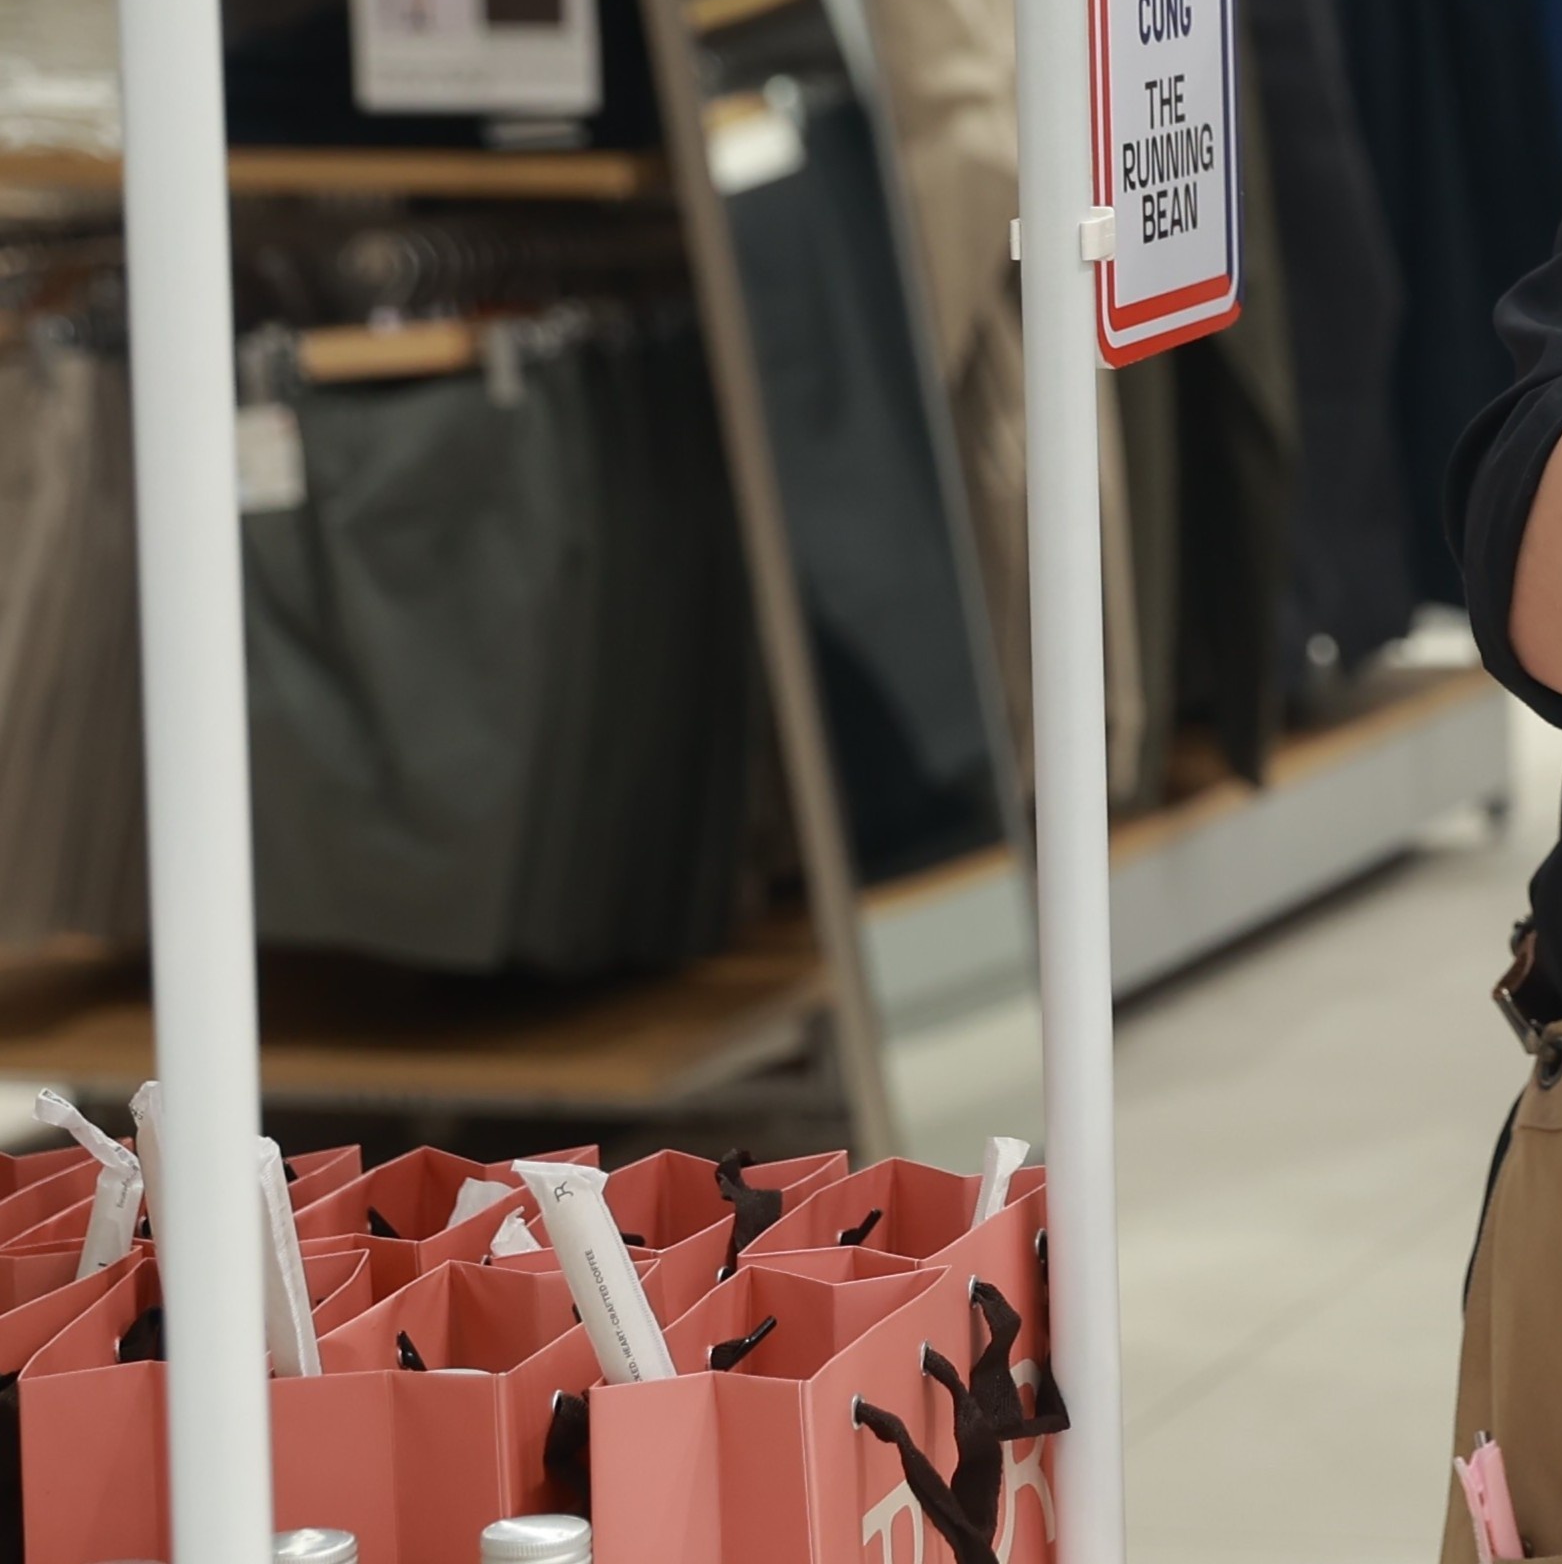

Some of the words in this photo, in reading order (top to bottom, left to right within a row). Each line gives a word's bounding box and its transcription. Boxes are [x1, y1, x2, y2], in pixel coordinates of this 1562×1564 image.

[1144, 74, 1186, 129] THE
[1123, 123, 1214, 193] RUNNING
[1141, 182, 1198, 245] BEAN
[585, 1248, 604, 1285] COFFEE
